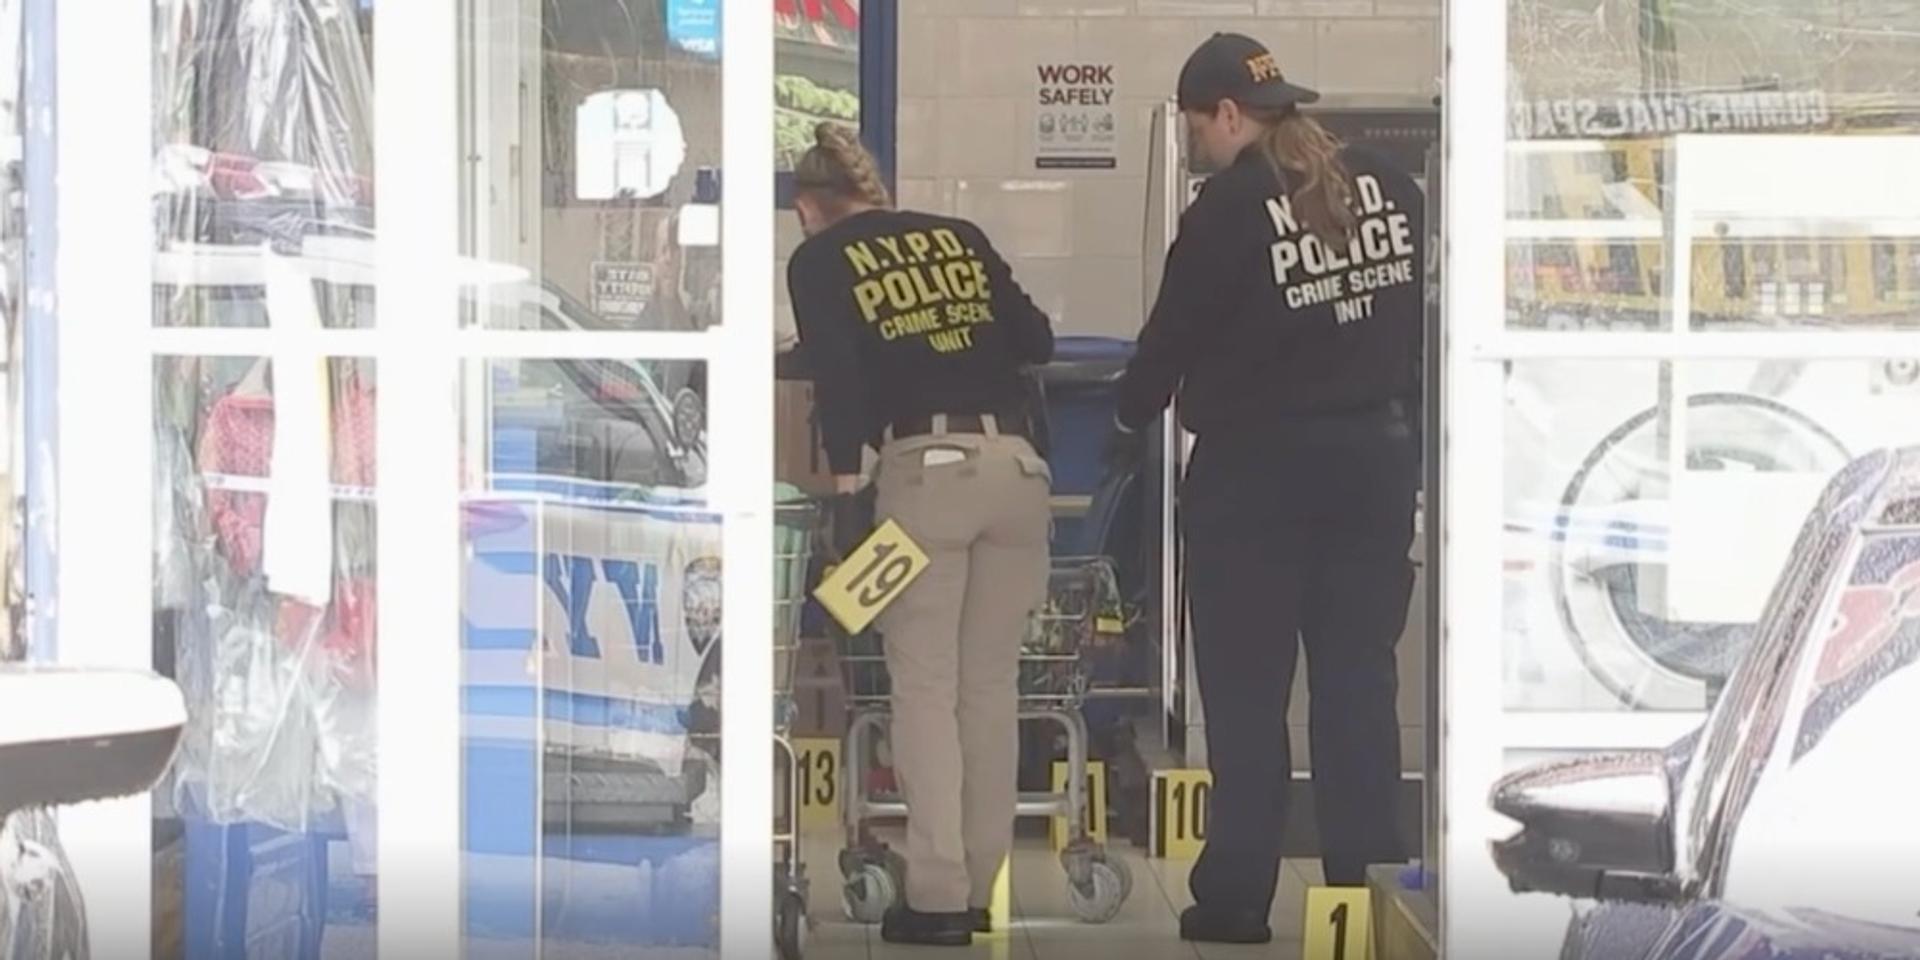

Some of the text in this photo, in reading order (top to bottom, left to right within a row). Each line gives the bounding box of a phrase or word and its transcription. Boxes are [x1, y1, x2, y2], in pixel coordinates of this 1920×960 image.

[1037, 65, 1113, 85] WORK
[1039, 88, 1113, 105] SAFELY
[844, 228, 975, 277] N.Y.P.D.
[1270, 213, 1414, 285] POLICE
[853, 260, 991, 323] POLICE
[1348, 259, 1413, 293] SCENE
[880, 307, 941, 340] CRIME
[927, 326, 972, 353] UNIT
[845, 541, 913, 608] 19
[797, 749, 835, 806] 13
[1173, 781, 1208, 840] 10
[1329, 902, 1349, 960] 1
